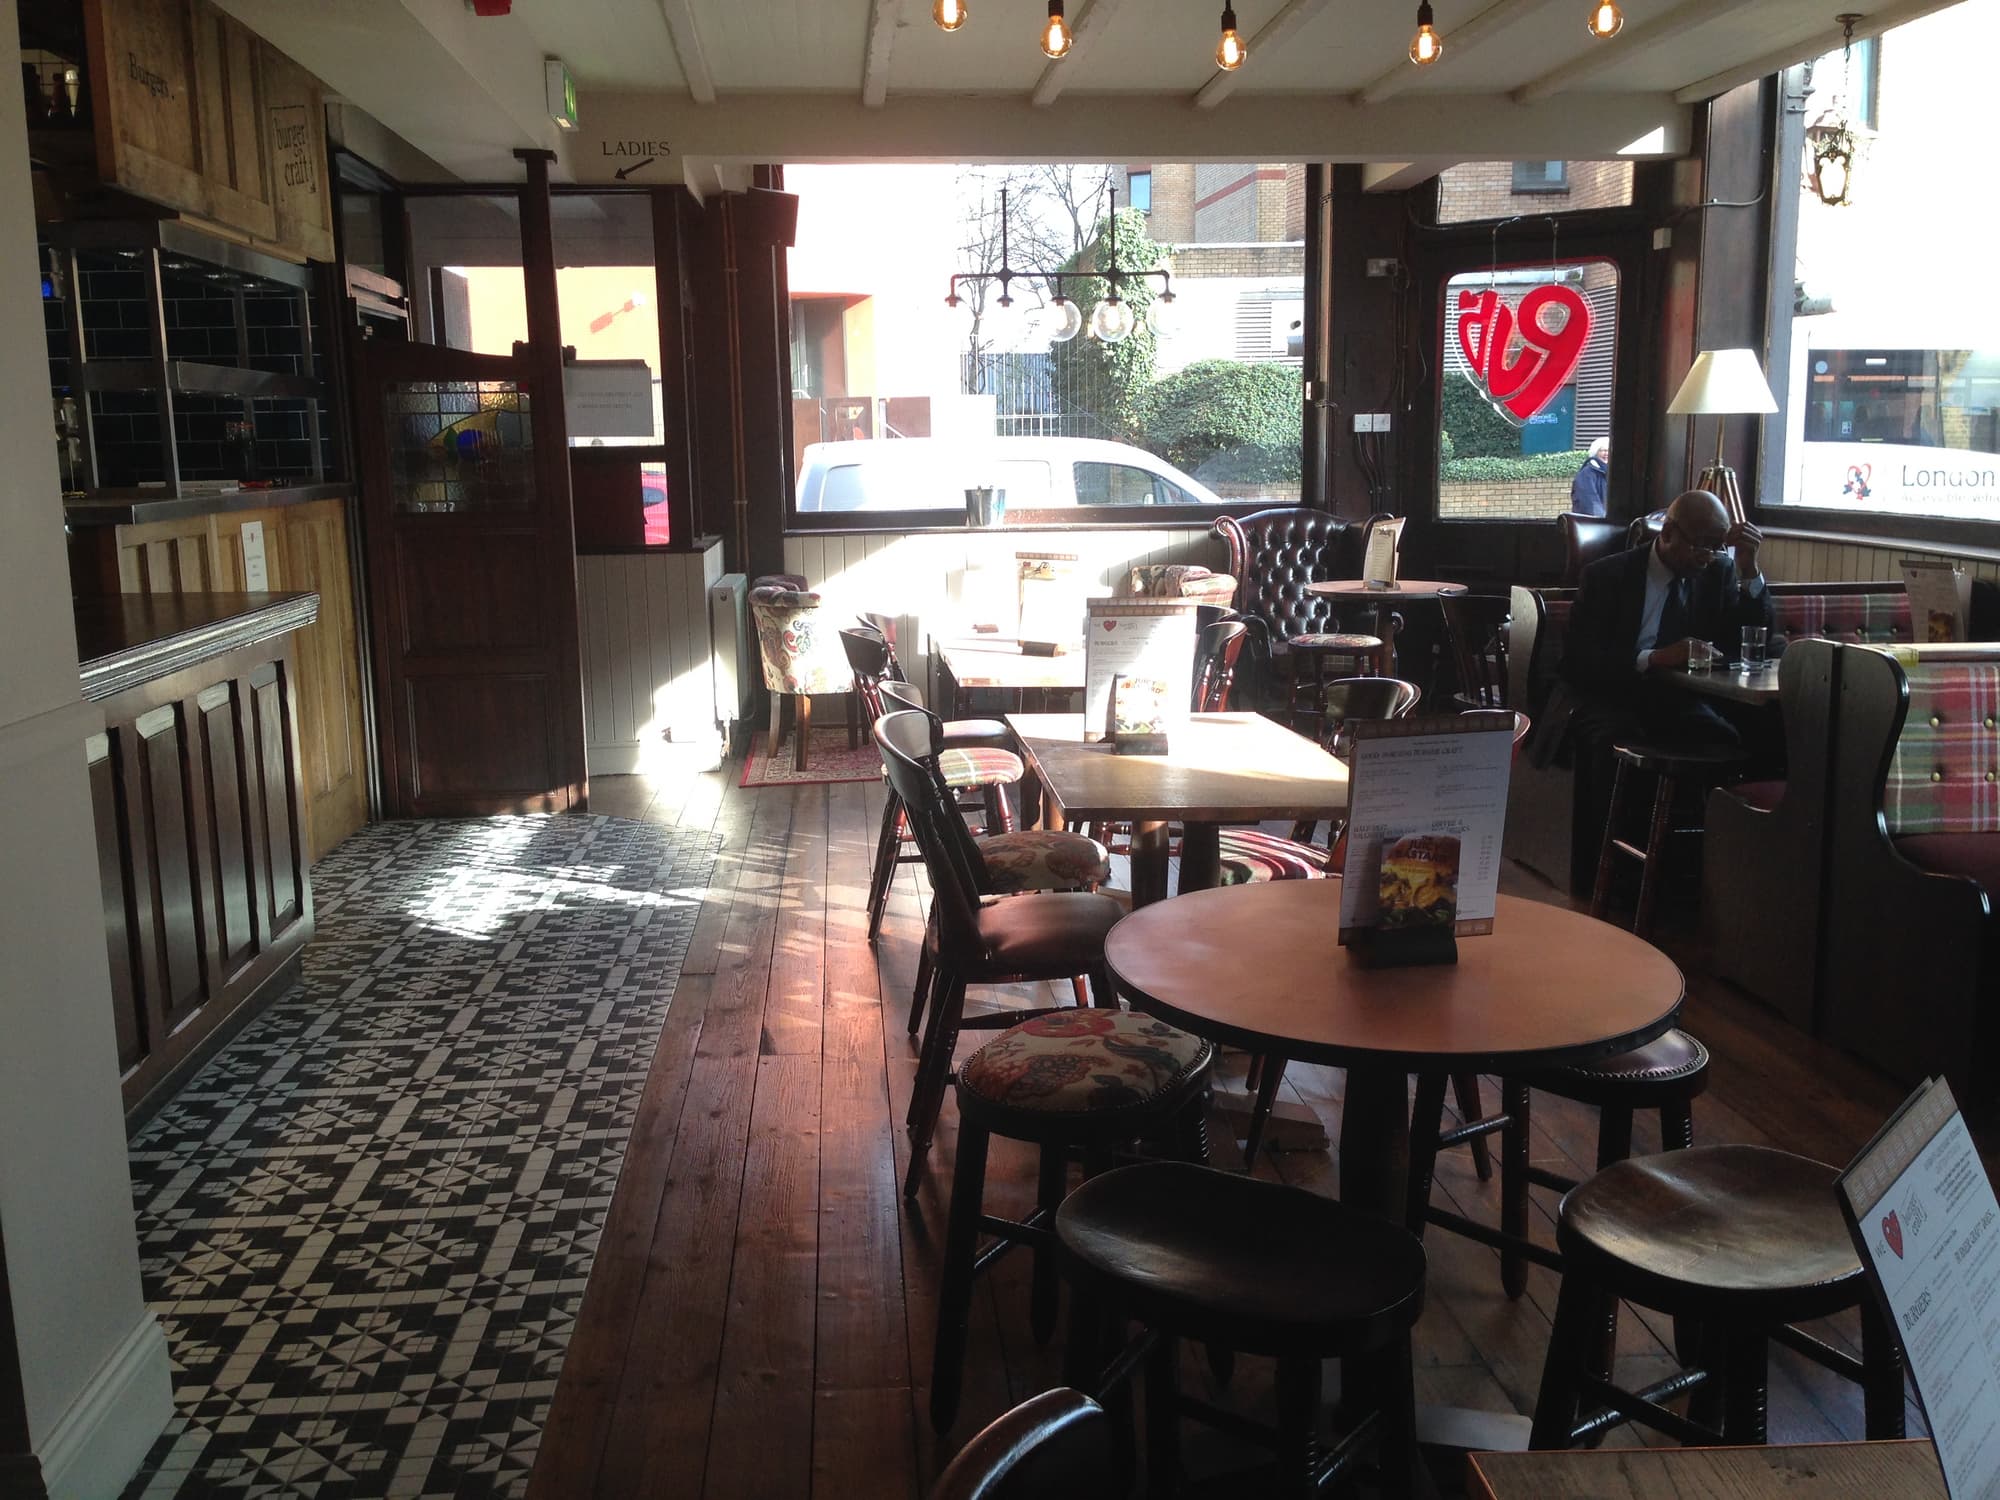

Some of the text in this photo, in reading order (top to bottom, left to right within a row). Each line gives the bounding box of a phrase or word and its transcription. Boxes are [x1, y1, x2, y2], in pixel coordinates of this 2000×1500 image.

[602, 141, 671, 156] LADIES
[1902, 464, 1995, 487] London
[1902, 1286, 1932, 1332] BURGERS
